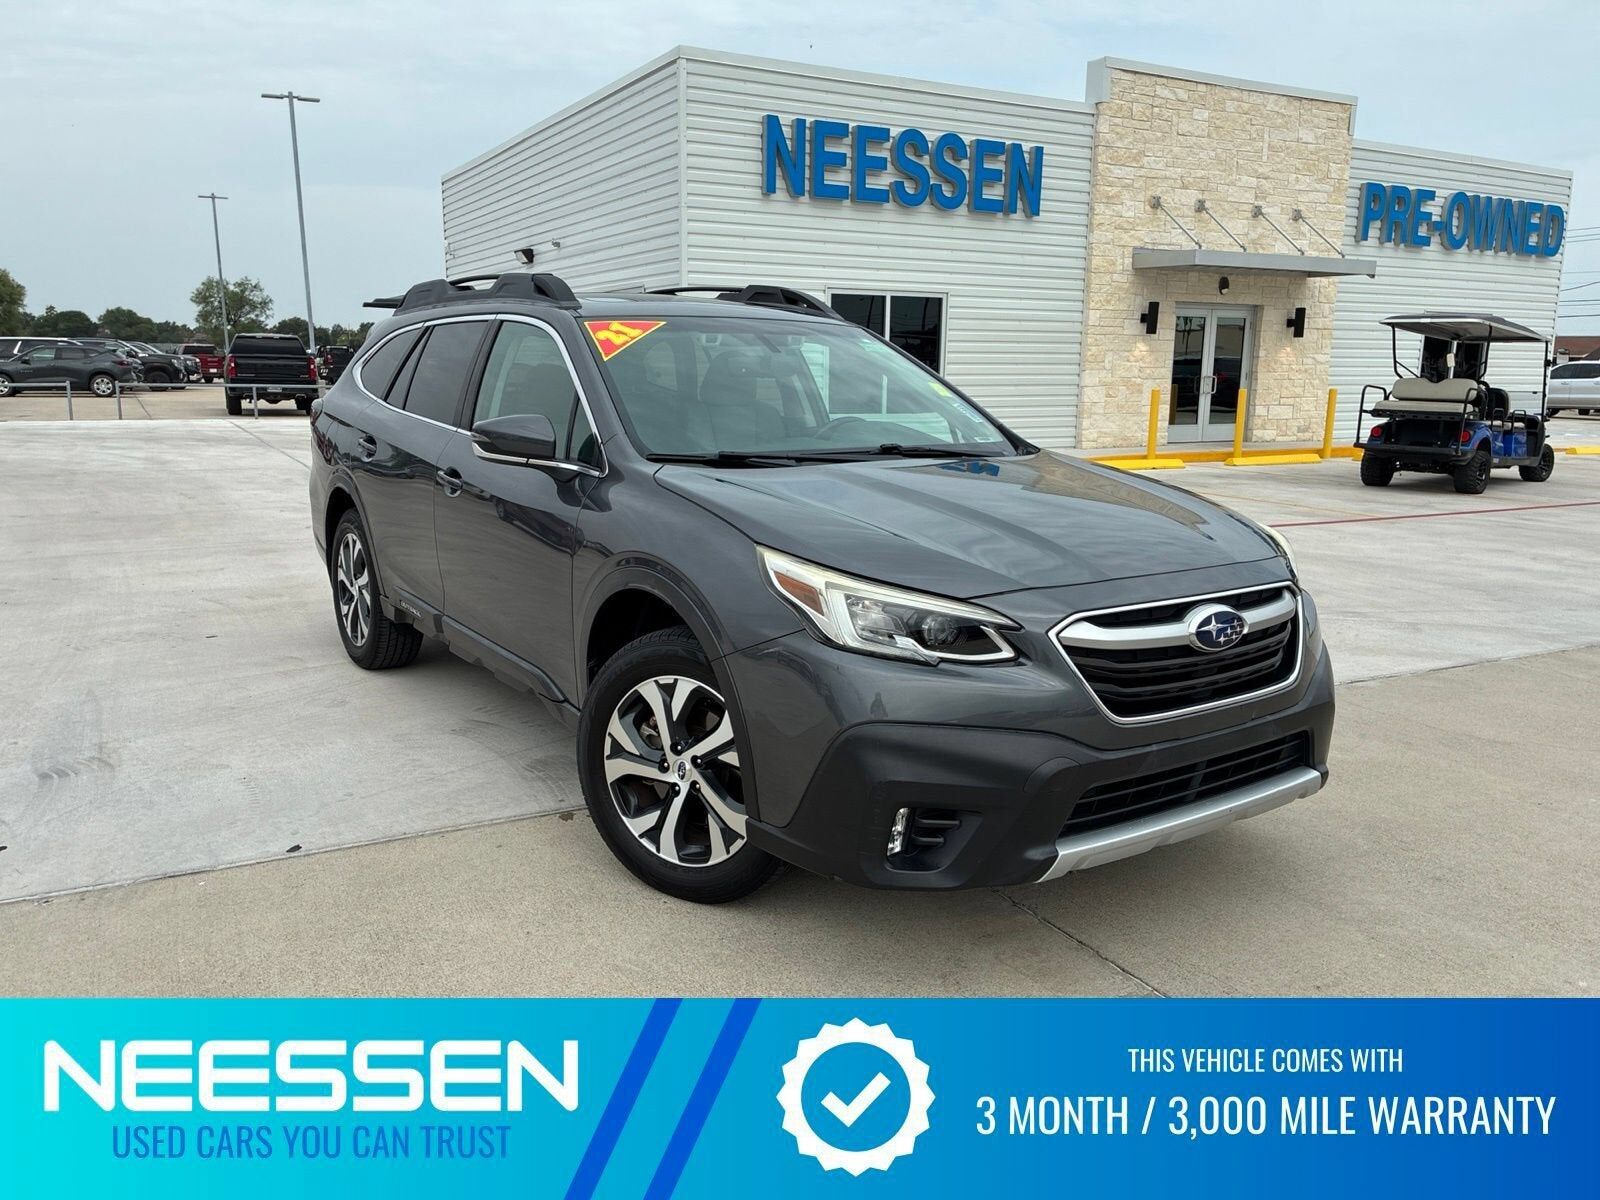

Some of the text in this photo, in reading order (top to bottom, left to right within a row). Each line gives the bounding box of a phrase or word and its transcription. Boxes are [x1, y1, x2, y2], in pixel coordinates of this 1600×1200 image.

[761, 113, 1044, 218] NEESSEN
[1355, 181, 1566, 258] PRE-OWNED
[594, 321, 644, 346] 21
